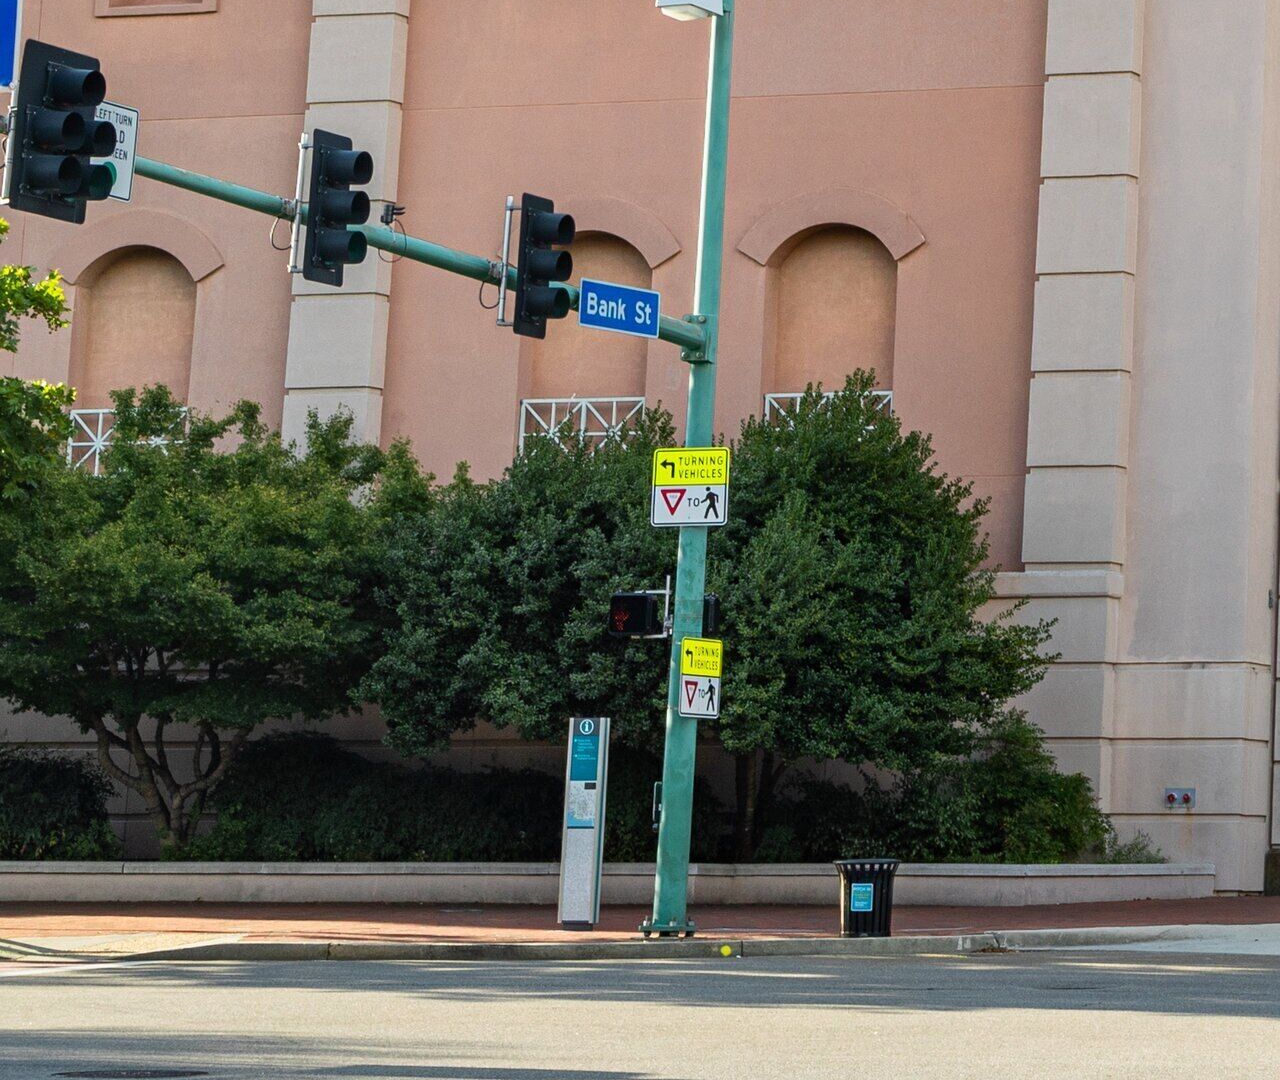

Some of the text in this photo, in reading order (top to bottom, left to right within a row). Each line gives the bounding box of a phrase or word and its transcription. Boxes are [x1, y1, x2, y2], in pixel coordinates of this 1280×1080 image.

[96, 107, 133, 126] LEFT TURN
[112, 148, 128, 161] EEN
[586, 291, 652, 325] Bank St
[678, 455, 724, 467] TURNING
[678, 468, 723, 479] VEHICLES
[687, 497, 700, 507] TO
[694, 646, 720, 658] TURNING
[694, 660, 719, 671] VEHICLES
[698, 688, 706, 699] TO
